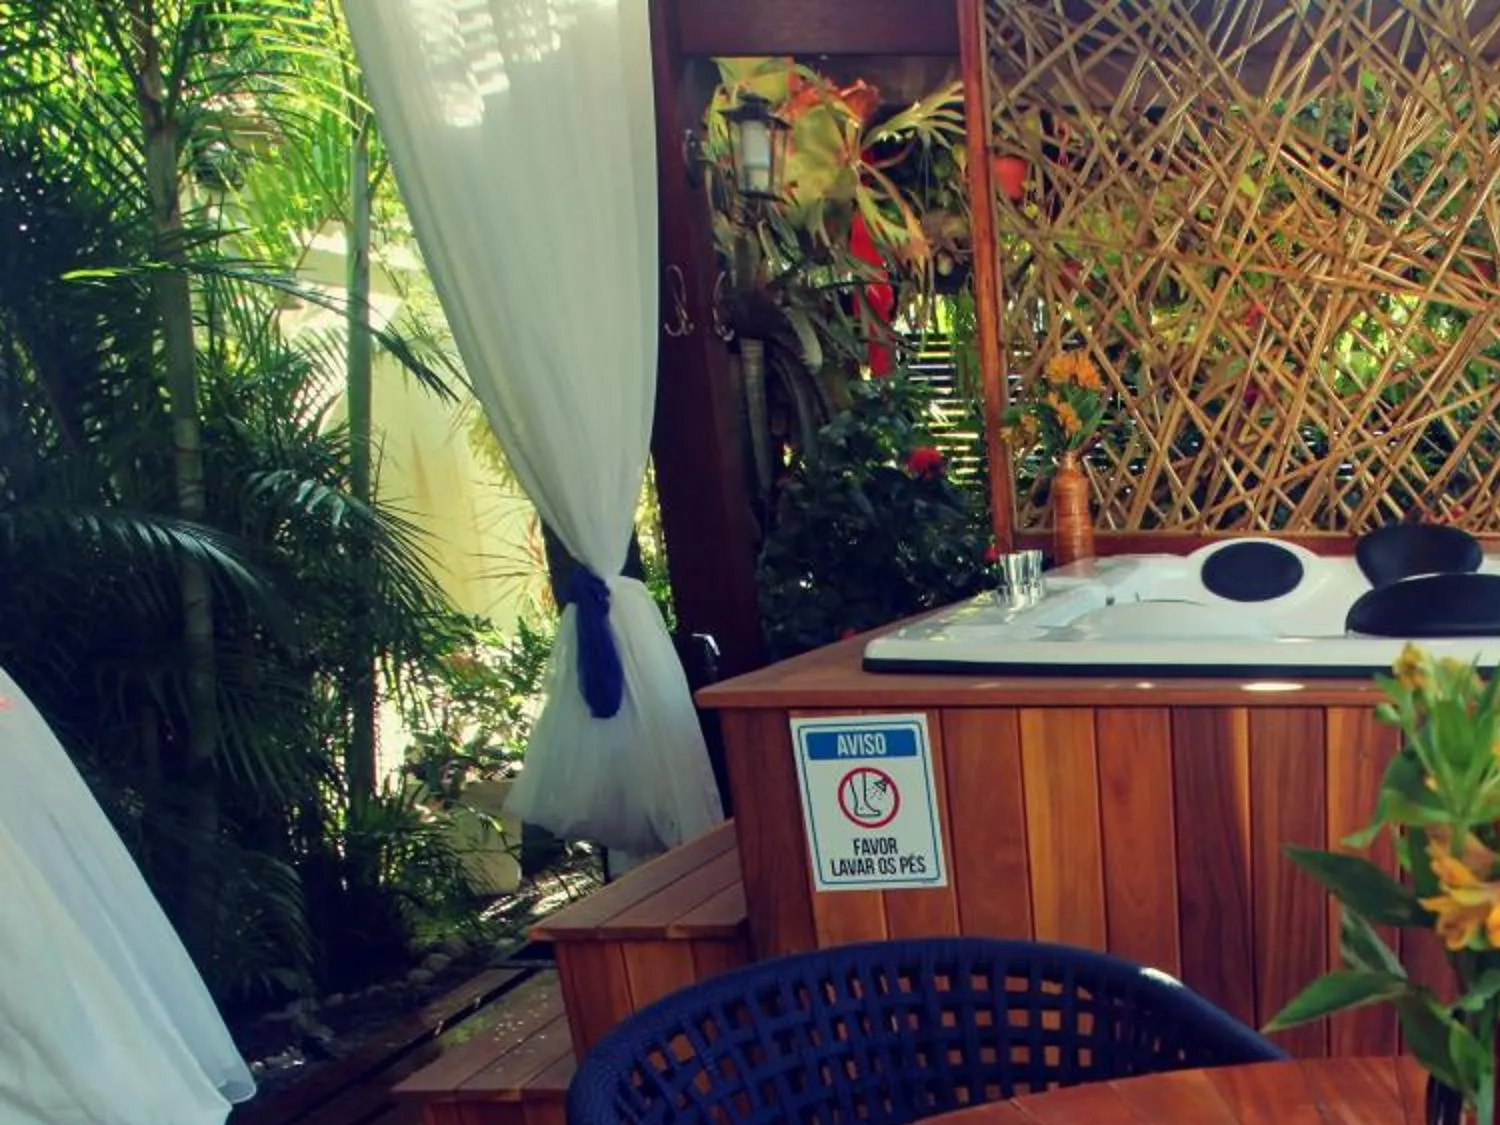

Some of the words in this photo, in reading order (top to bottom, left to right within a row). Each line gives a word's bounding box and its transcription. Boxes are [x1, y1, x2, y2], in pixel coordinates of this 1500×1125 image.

[837, 733, 887, 756] AVISO
[853, 837, 899, 856] FAVOR
[830, 858, 875, 876] LAVAR
[878, 857, 897, 875] OS
